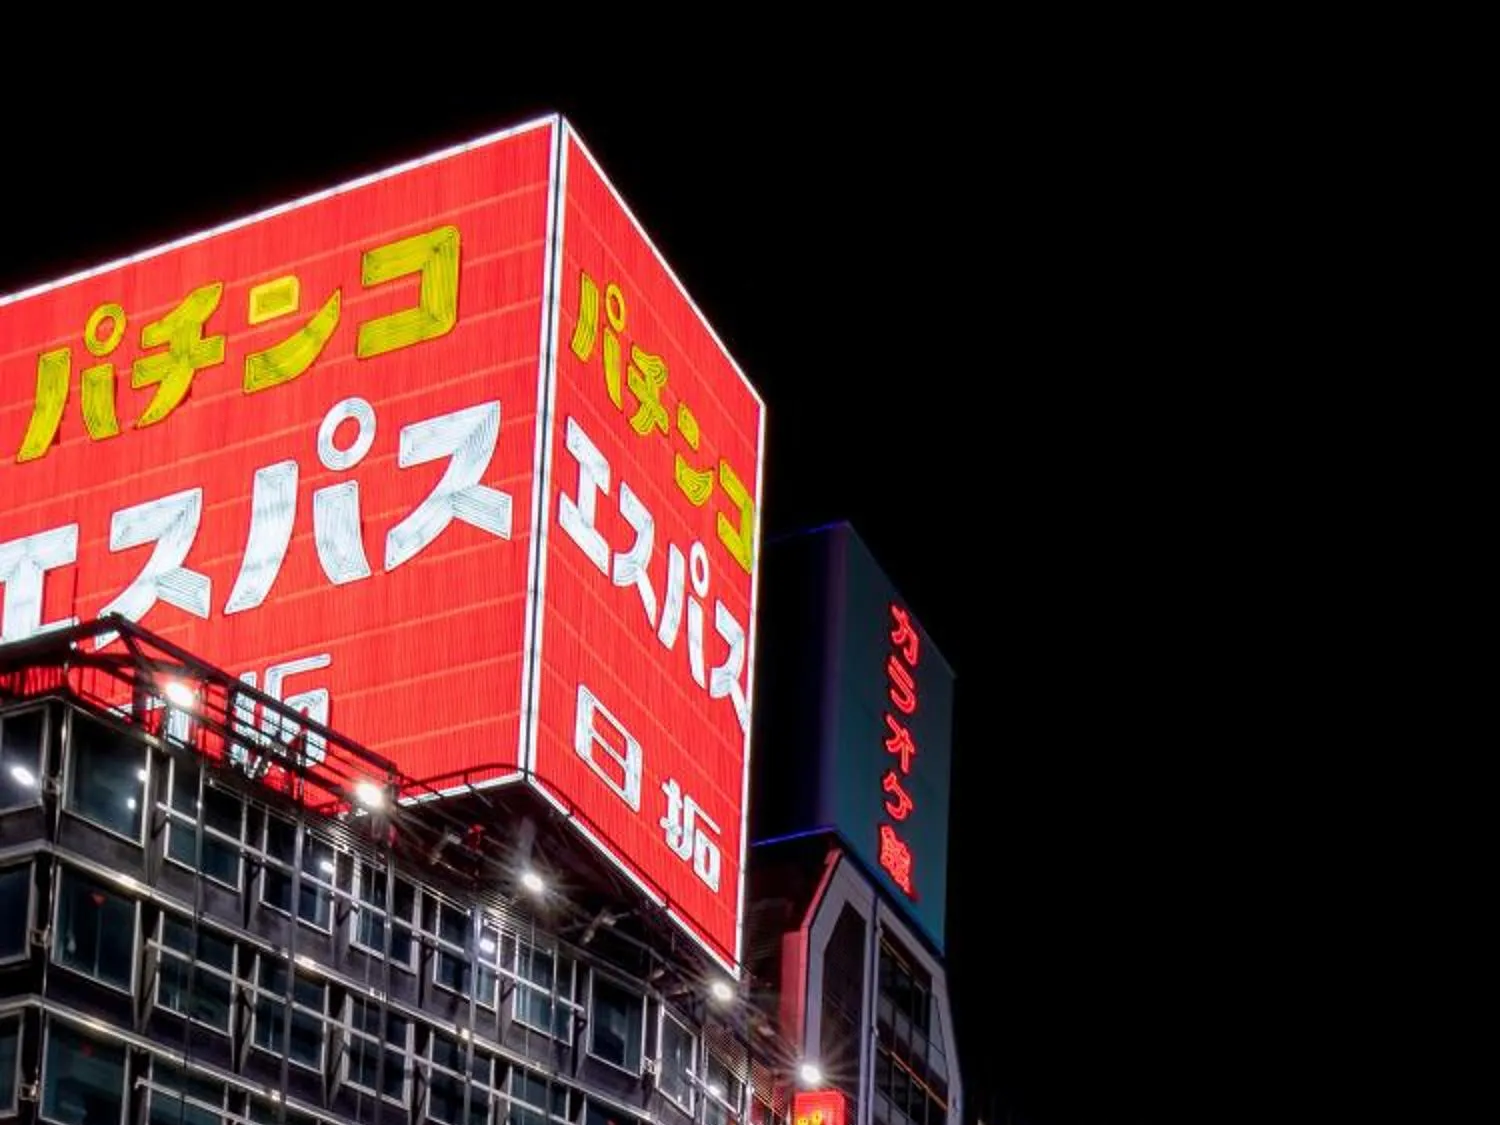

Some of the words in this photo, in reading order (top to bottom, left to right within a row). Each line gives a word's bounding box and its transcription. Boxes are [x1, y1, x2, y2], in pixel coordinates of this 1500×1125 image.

[17, 226, 462, 462] パチンコ
[571, 271, 753, 574] パチンコ
[0, 397, 513, 650] エスパス
[558, 416, 747, 734] エスパス
